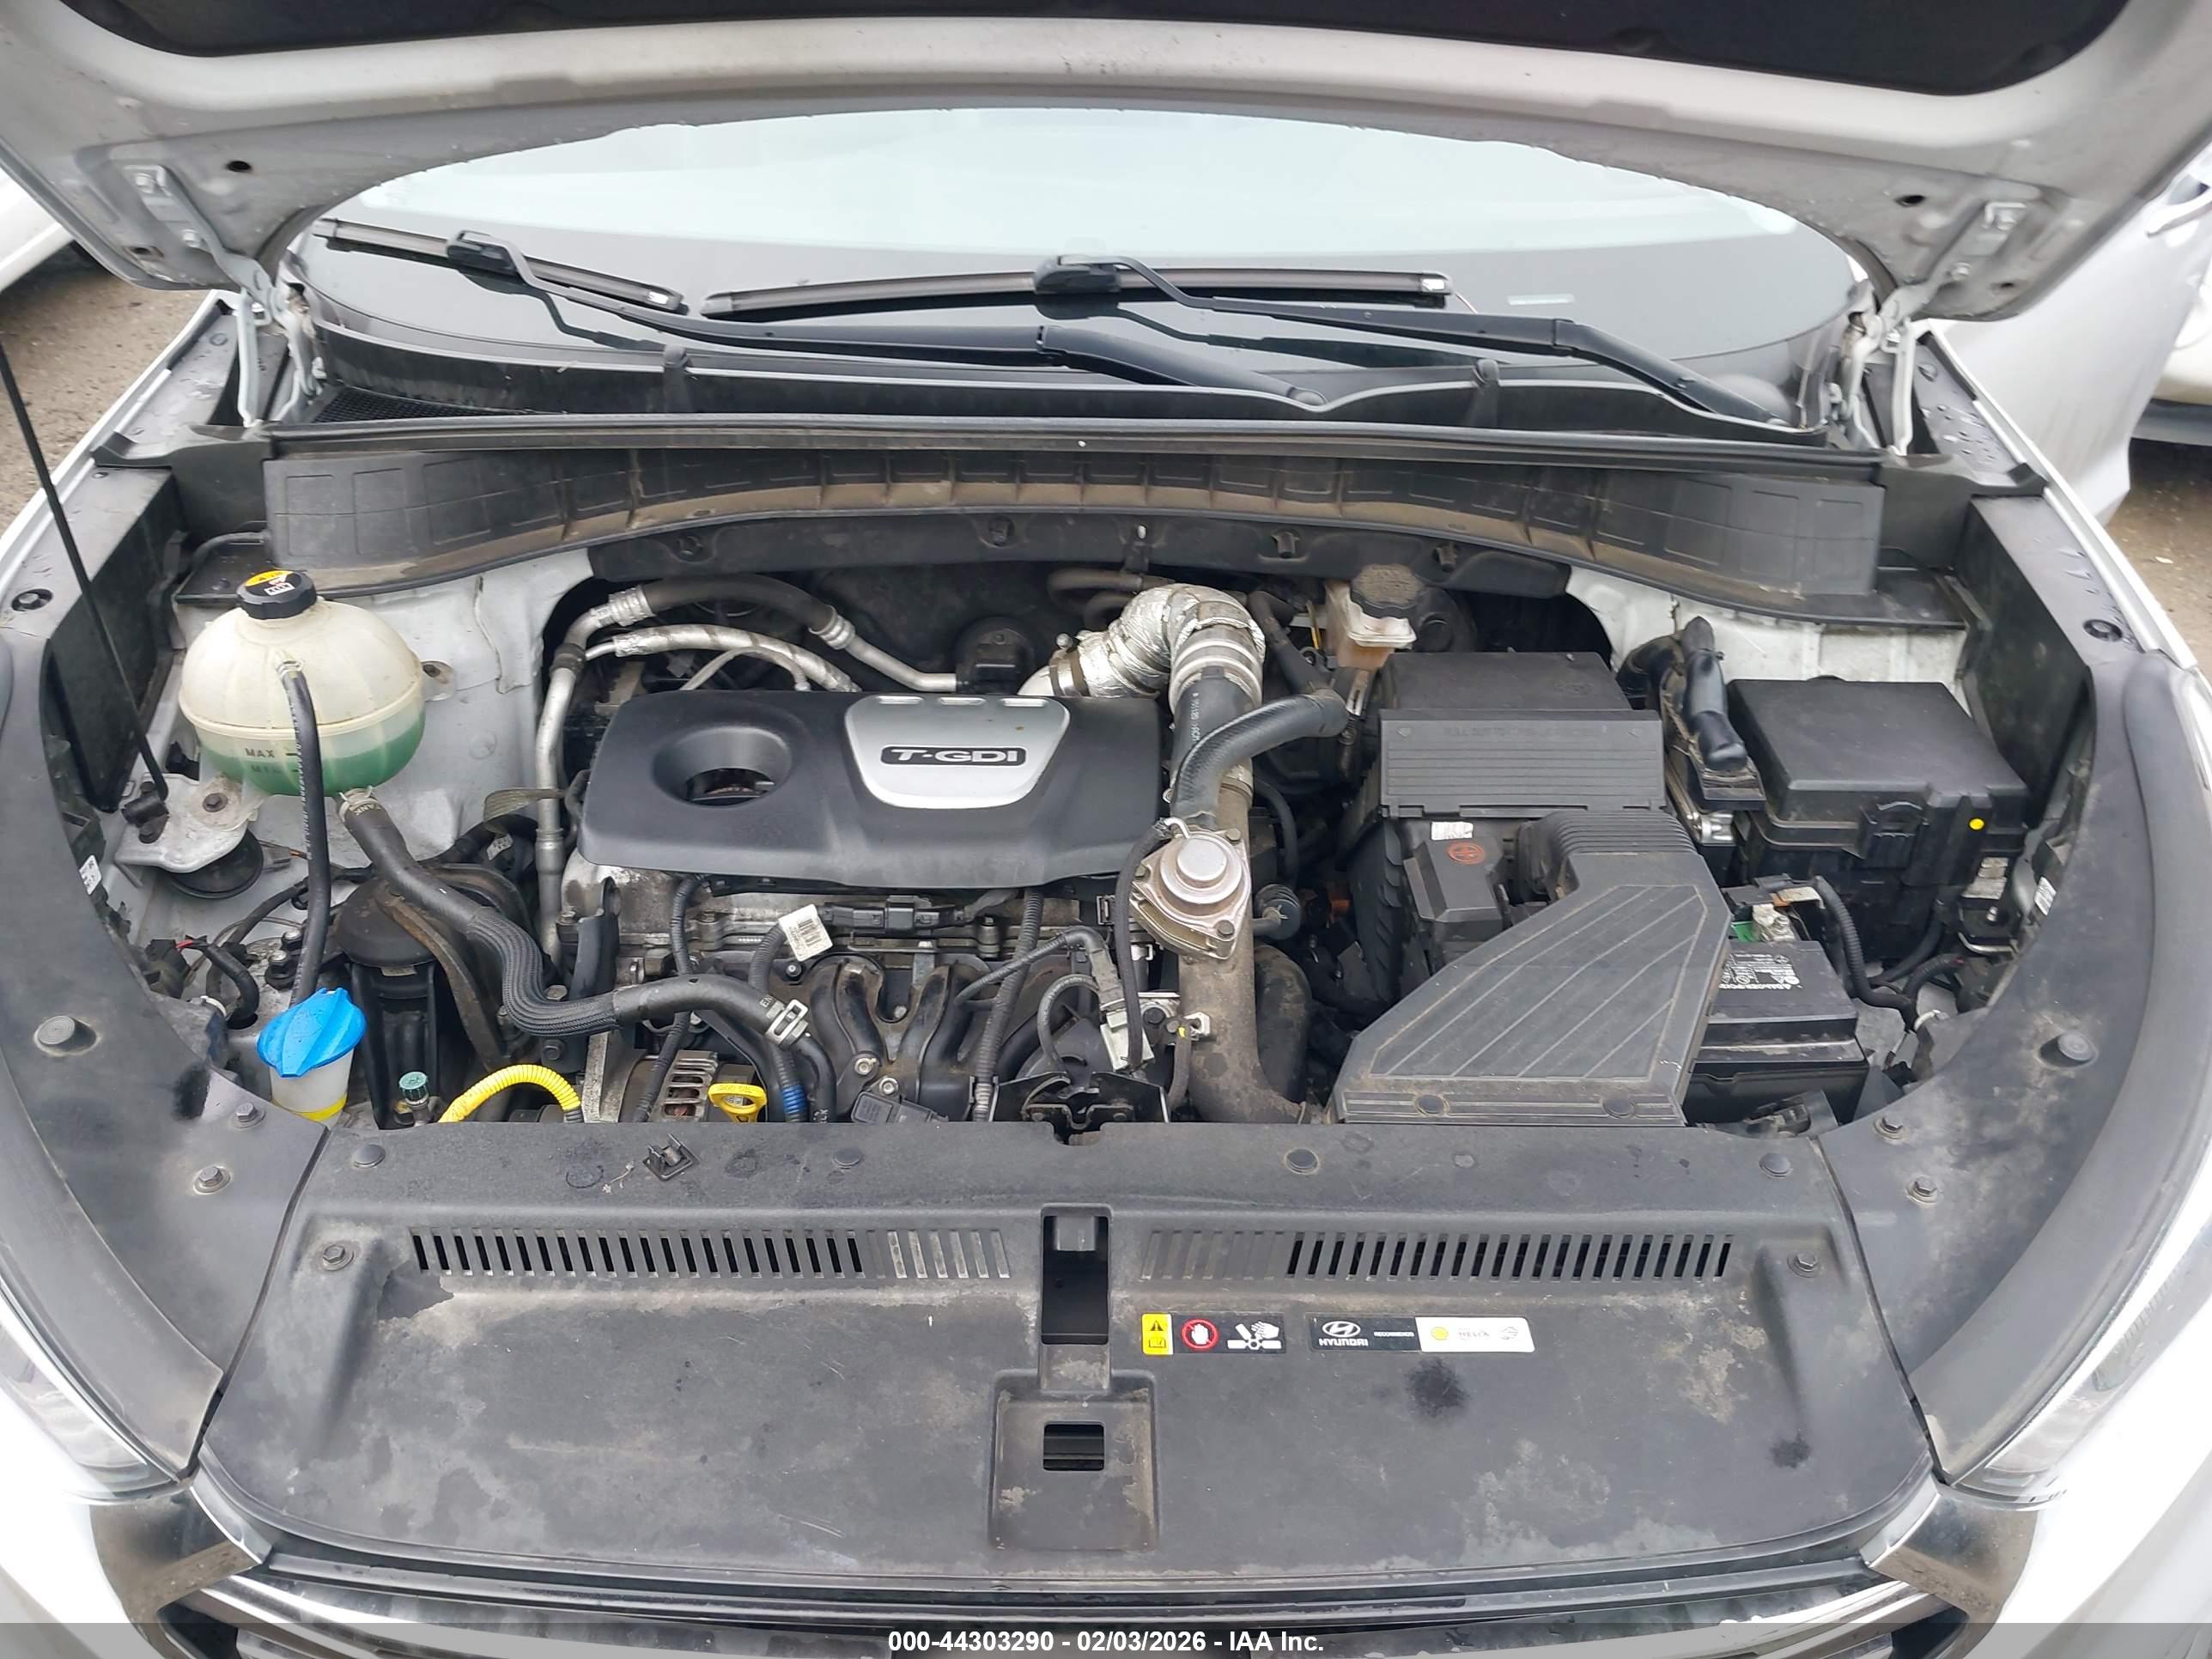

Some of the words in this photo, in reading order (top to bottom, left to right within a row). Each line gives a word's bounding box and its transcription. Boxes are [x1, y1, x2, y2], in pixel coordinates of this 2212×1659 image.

[244, 748, 275, 757] MAX
[1458, 1329, 1490, 1338] HELIX
[1319, 1338, 1368, 1346] HYUNDAI
